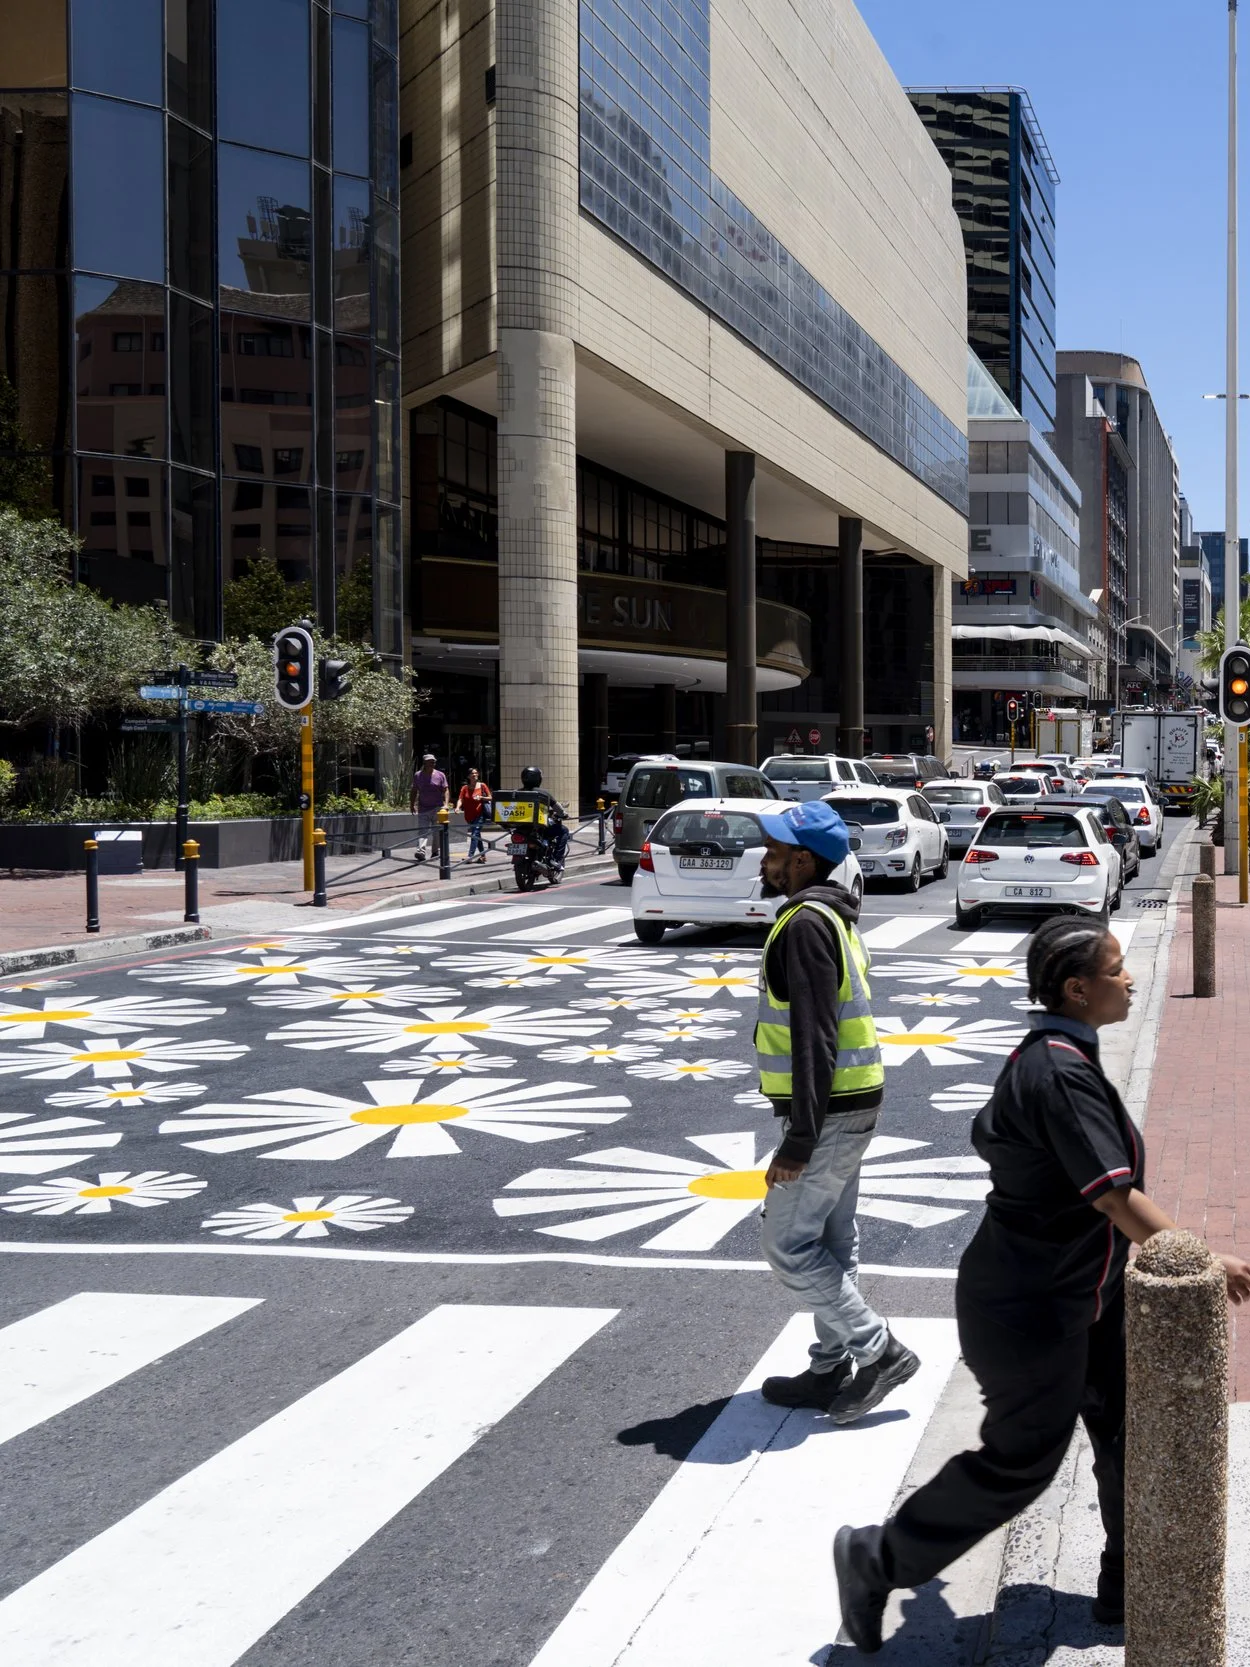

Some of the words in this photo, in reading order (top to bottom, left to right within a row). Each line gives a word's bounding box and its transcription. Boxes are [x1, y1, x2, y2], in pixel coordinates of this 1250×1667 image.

[612, 595, 673, 632] SUN
[682, 858, 696, 867] CAA
[700, 858, 730, 868] 363-129
[1013, 887, 1023, 896] CA
[1029, 888, 1044, 896] 812
